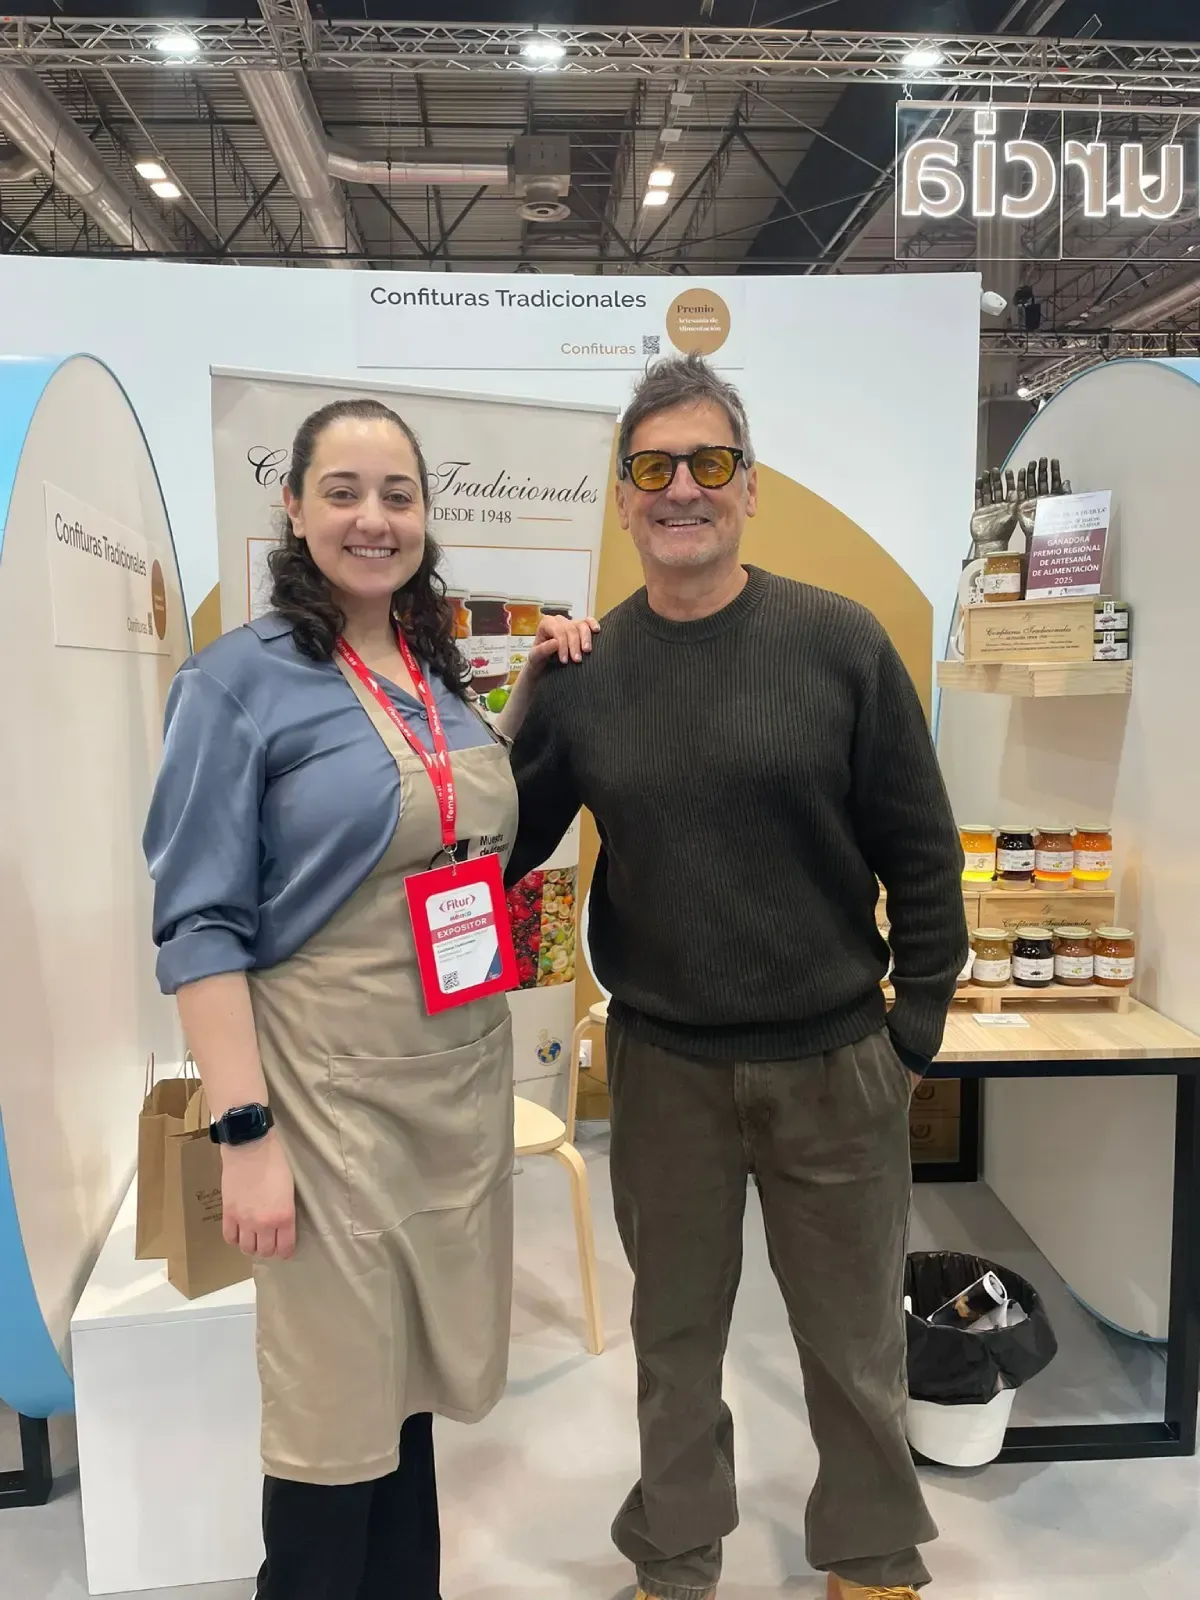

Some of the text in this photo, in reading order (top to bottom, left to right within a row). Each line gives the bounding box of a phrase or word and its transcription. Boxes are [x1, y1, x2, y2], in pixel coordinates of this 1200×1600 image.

[370, 286, 647, 308] Confituras Tradicionales
[677, 304, 714, 313] Premio
[560, 342, 636, 356] Confituras
[427, 461, 598, 503] Tradicionales
[433, 506, 512, 524] DESDE 1948
[55, 513, 147, 576] Confituras Tradicionales
[1047, 535, 1090, 547] GANADORA
[1033, 544, 1101, 558] PREMIO REGIONAL
[1039, 555, 1092, 567] DE ARTESANÍA
[1032, 564, 1100, 577] DE ALIMENTACIÓN
[1054, 576, 1073, 585] 2025
[446, 783, 454, 822] ifema.es
[446, 896, 470, 912] Fitur
[437, 917, 487, 939] EXPOSITOR
